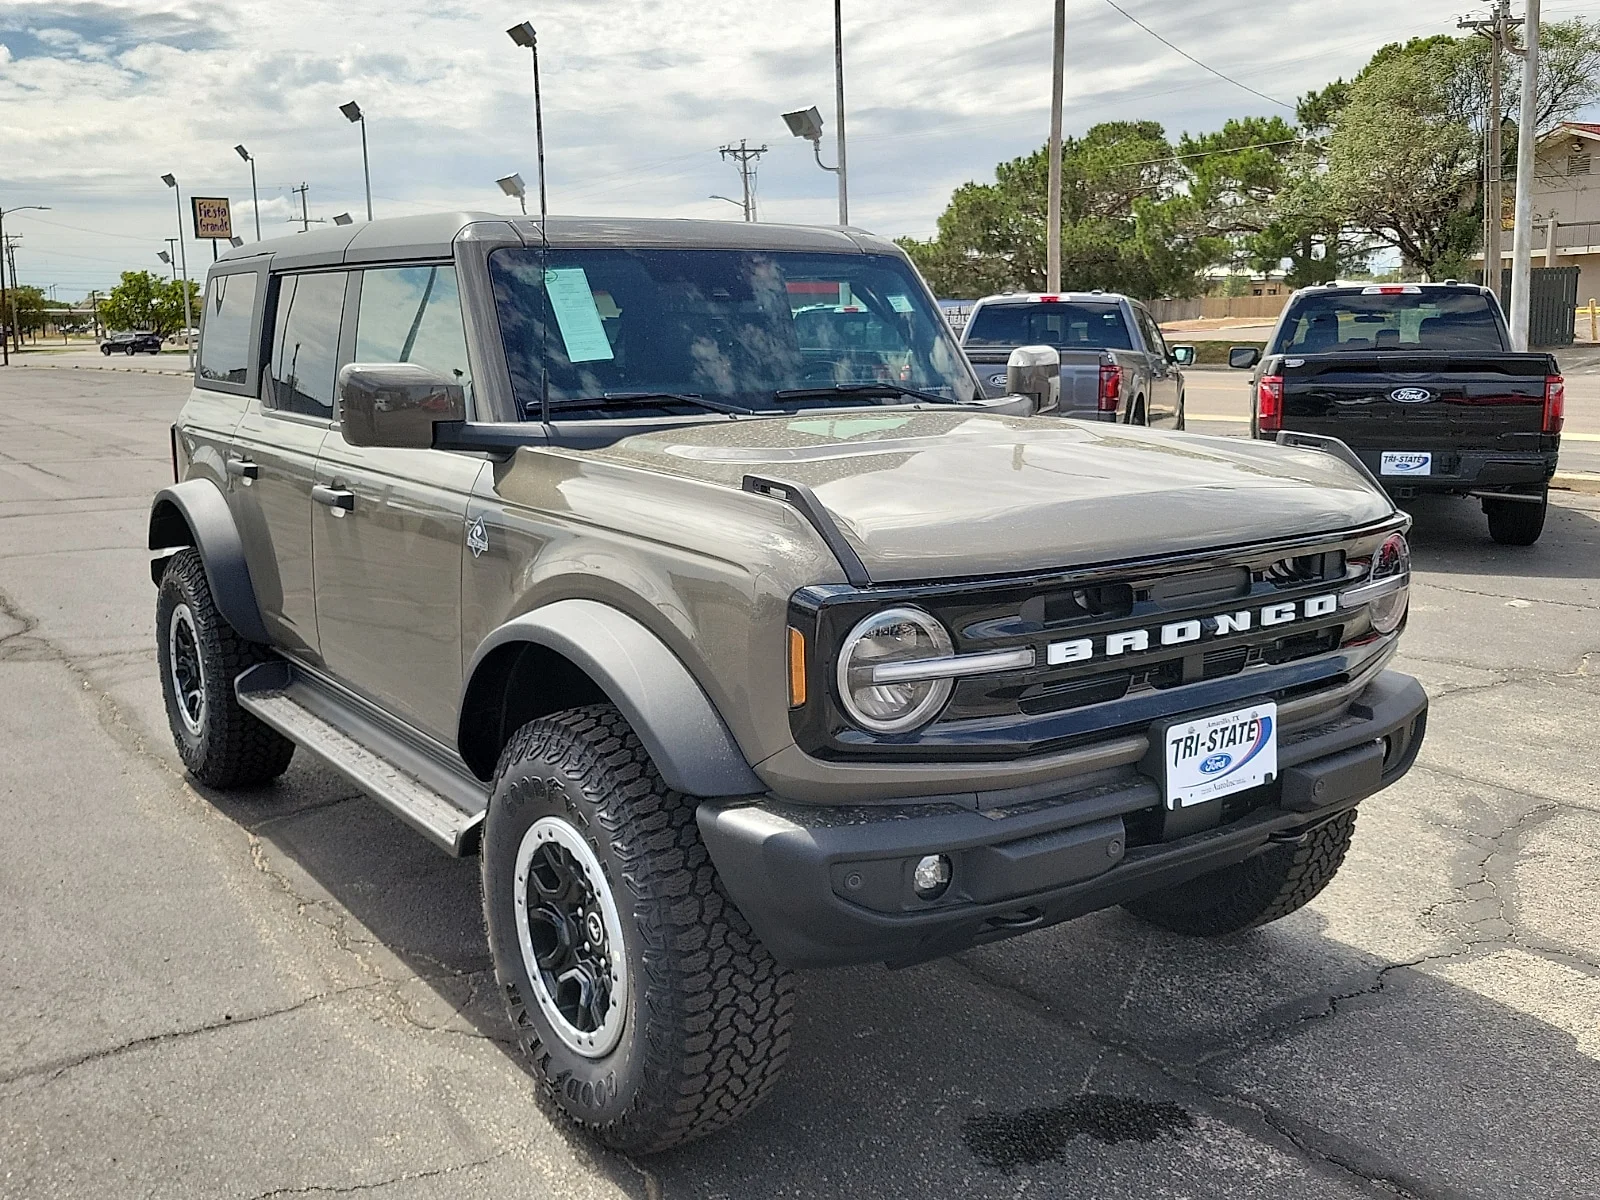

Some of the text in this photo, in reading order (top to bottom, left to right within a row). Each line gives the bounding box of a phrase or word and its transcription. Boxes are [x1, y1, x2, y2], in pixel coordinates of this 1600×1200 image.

[198, 201, 227, 218] Fiesta
[199, 218, 229, 232] Grande
[1397, 389, 1424, 400] Ford
[1383, 455, 1423, 464] TRI-STATE
[1047, 594, 1337, 665] BRONCO
[1171, 719, 1258, 768] TRI-STATE
[1203, 755, 1228, 772] Ford
